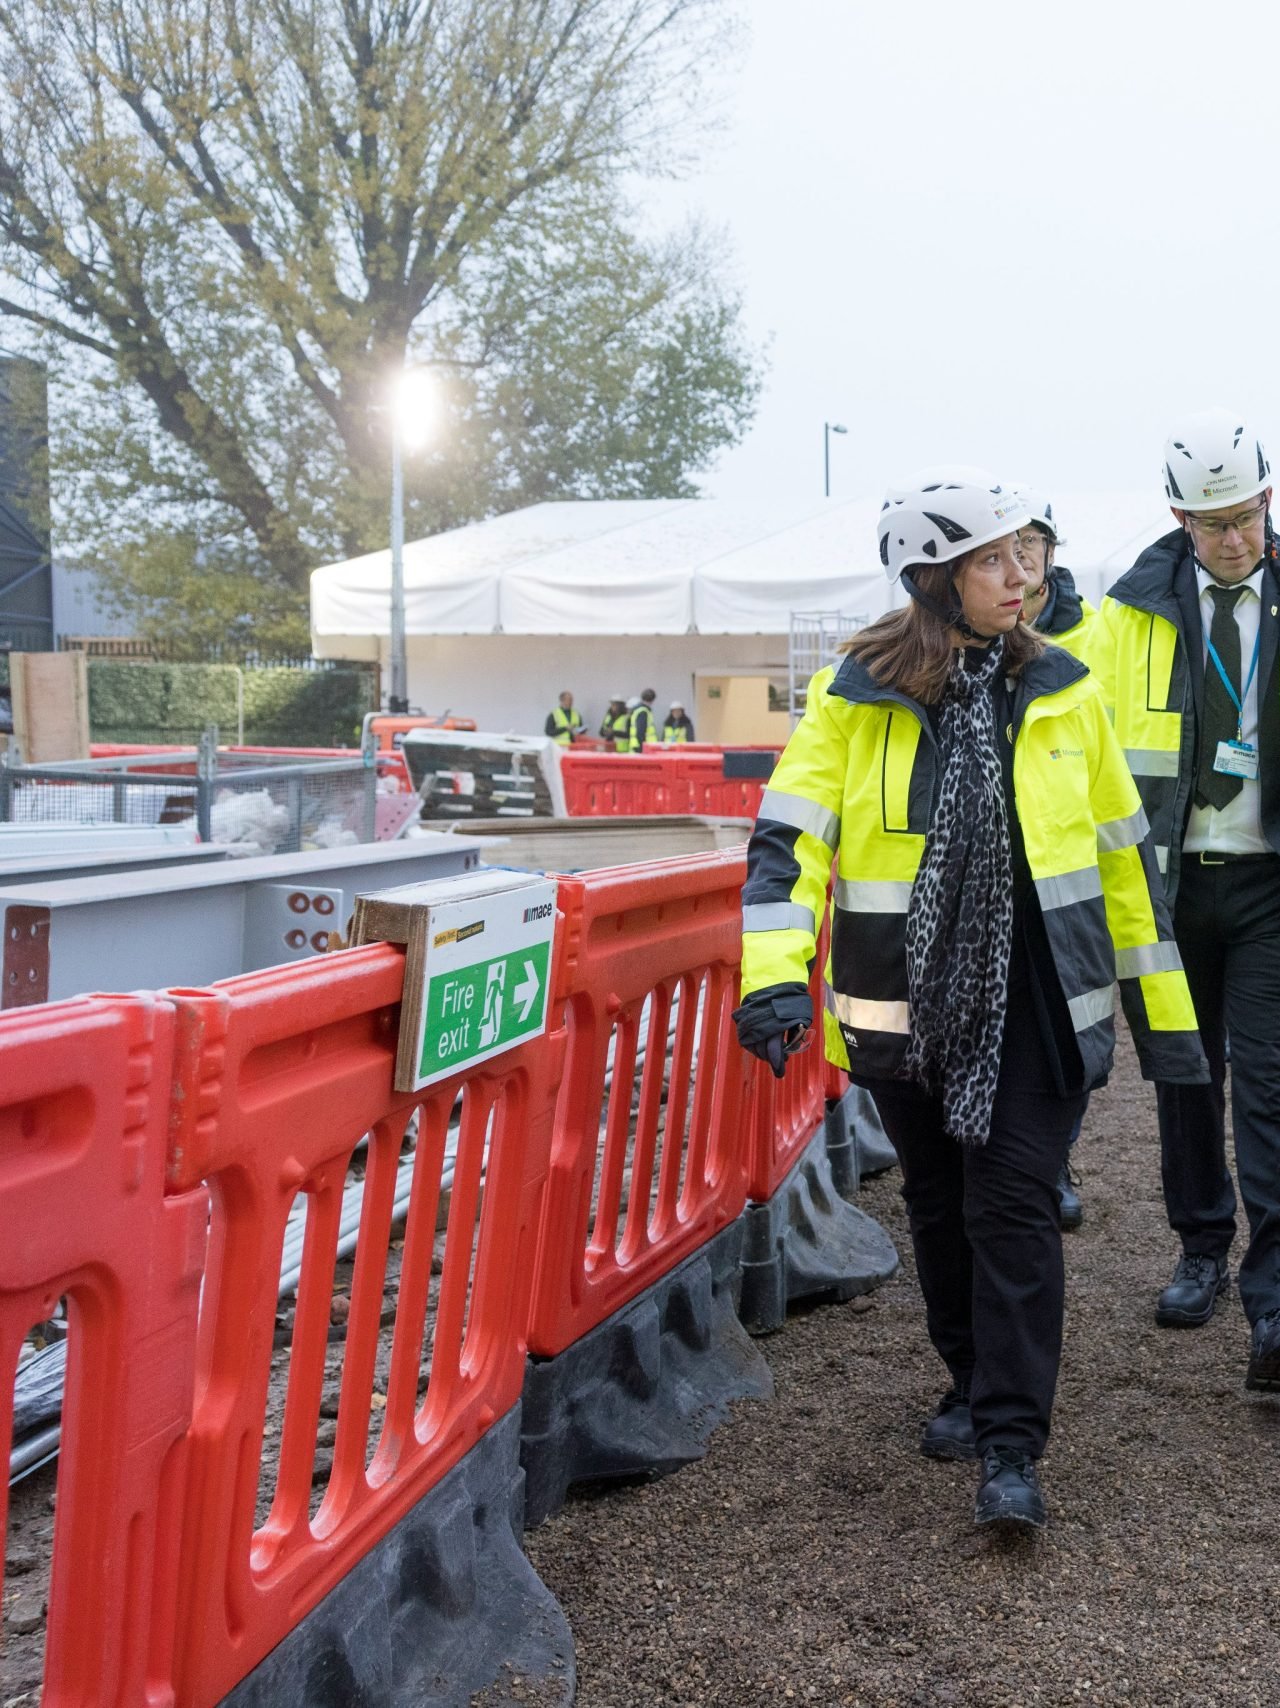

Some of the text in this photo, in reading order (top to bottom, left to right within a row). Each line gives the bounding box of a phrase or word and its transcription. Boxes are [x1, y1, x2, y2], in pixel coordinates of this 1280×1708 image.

[1213, 484, 1238, 494] Microsoft
[532, 902, 553, 921] mace
[441, 981, 475, 1019] Fire
[437, 1018, 470, 1059] exit
